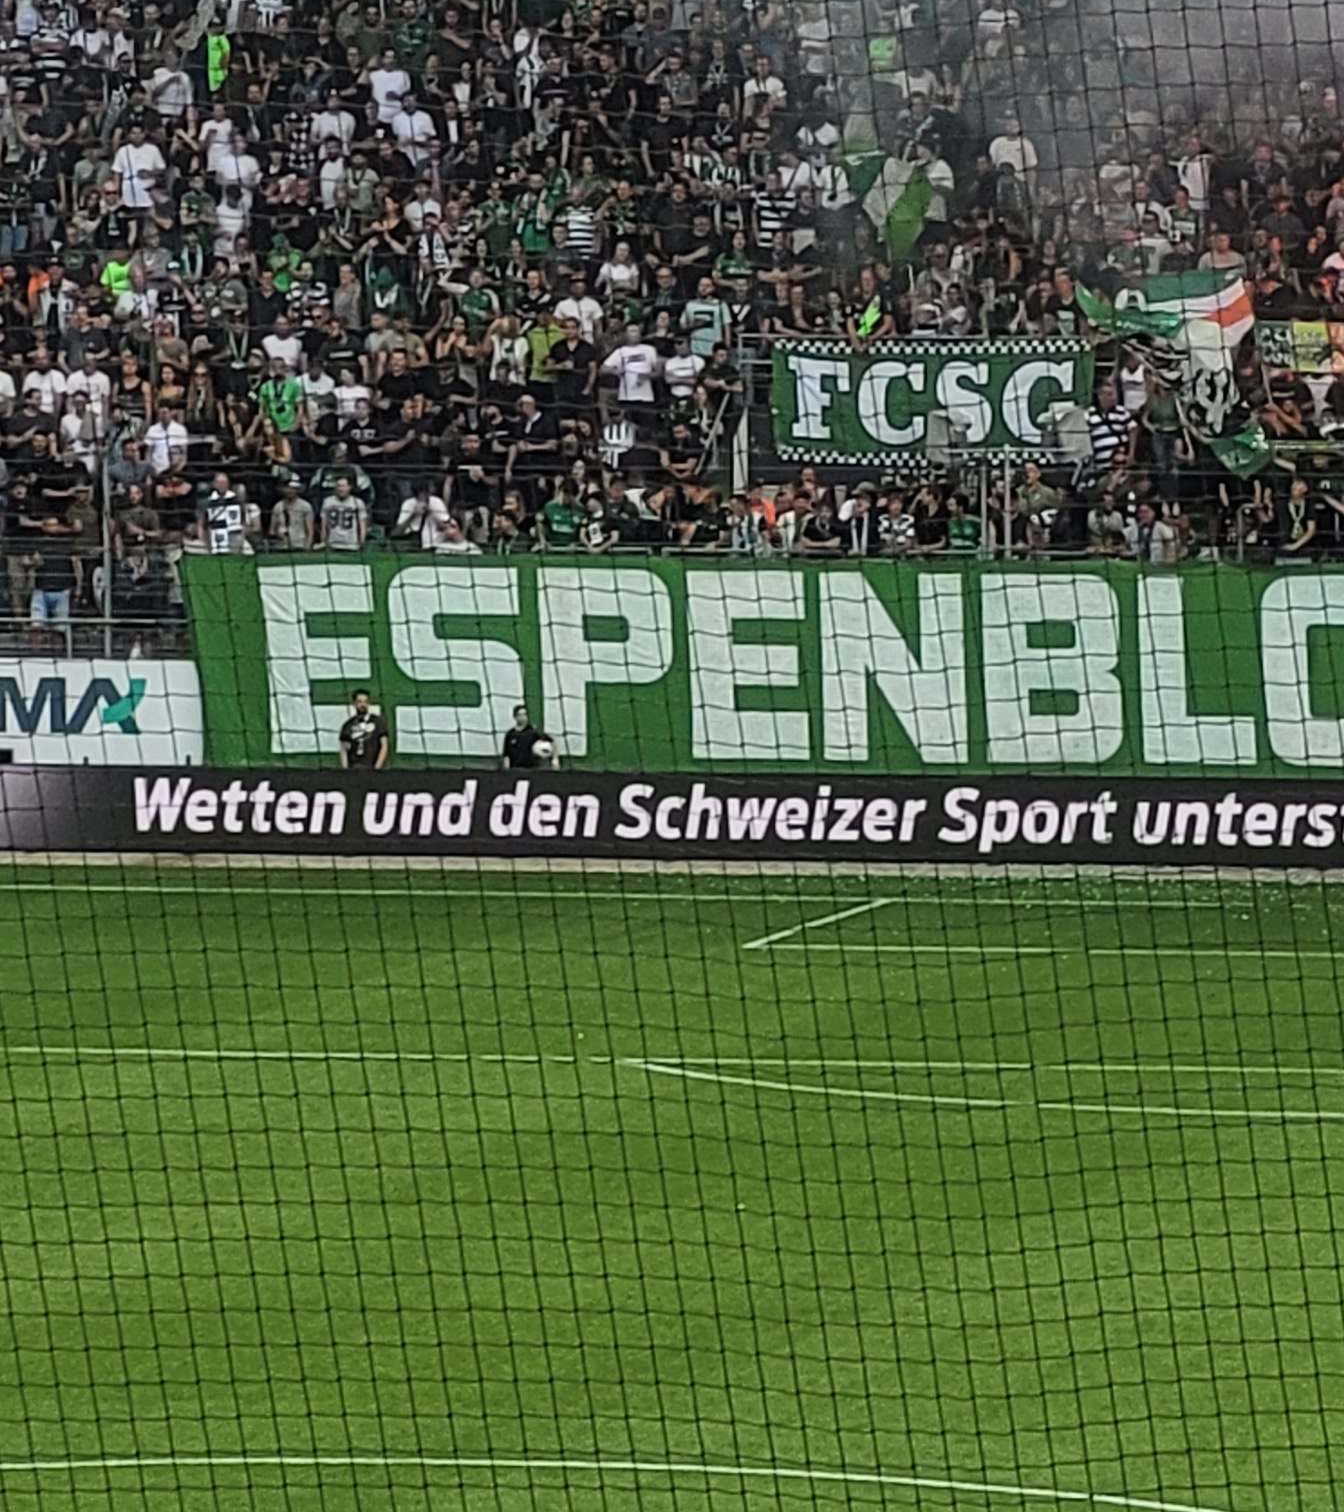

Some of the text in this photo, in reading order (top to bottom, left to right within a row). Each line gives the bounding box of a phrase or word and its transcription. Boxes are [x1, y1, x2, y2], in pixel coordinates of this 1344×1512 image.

[788, 354, 1074, 445] FCSG
[134, 777, 346, 835] Wetten
[363, 779, 477, 837] und
[488, 780, 600, 839] den
[614, 782, 928, 842] Schweizer
[937, 787, 1118, 853] Sport
